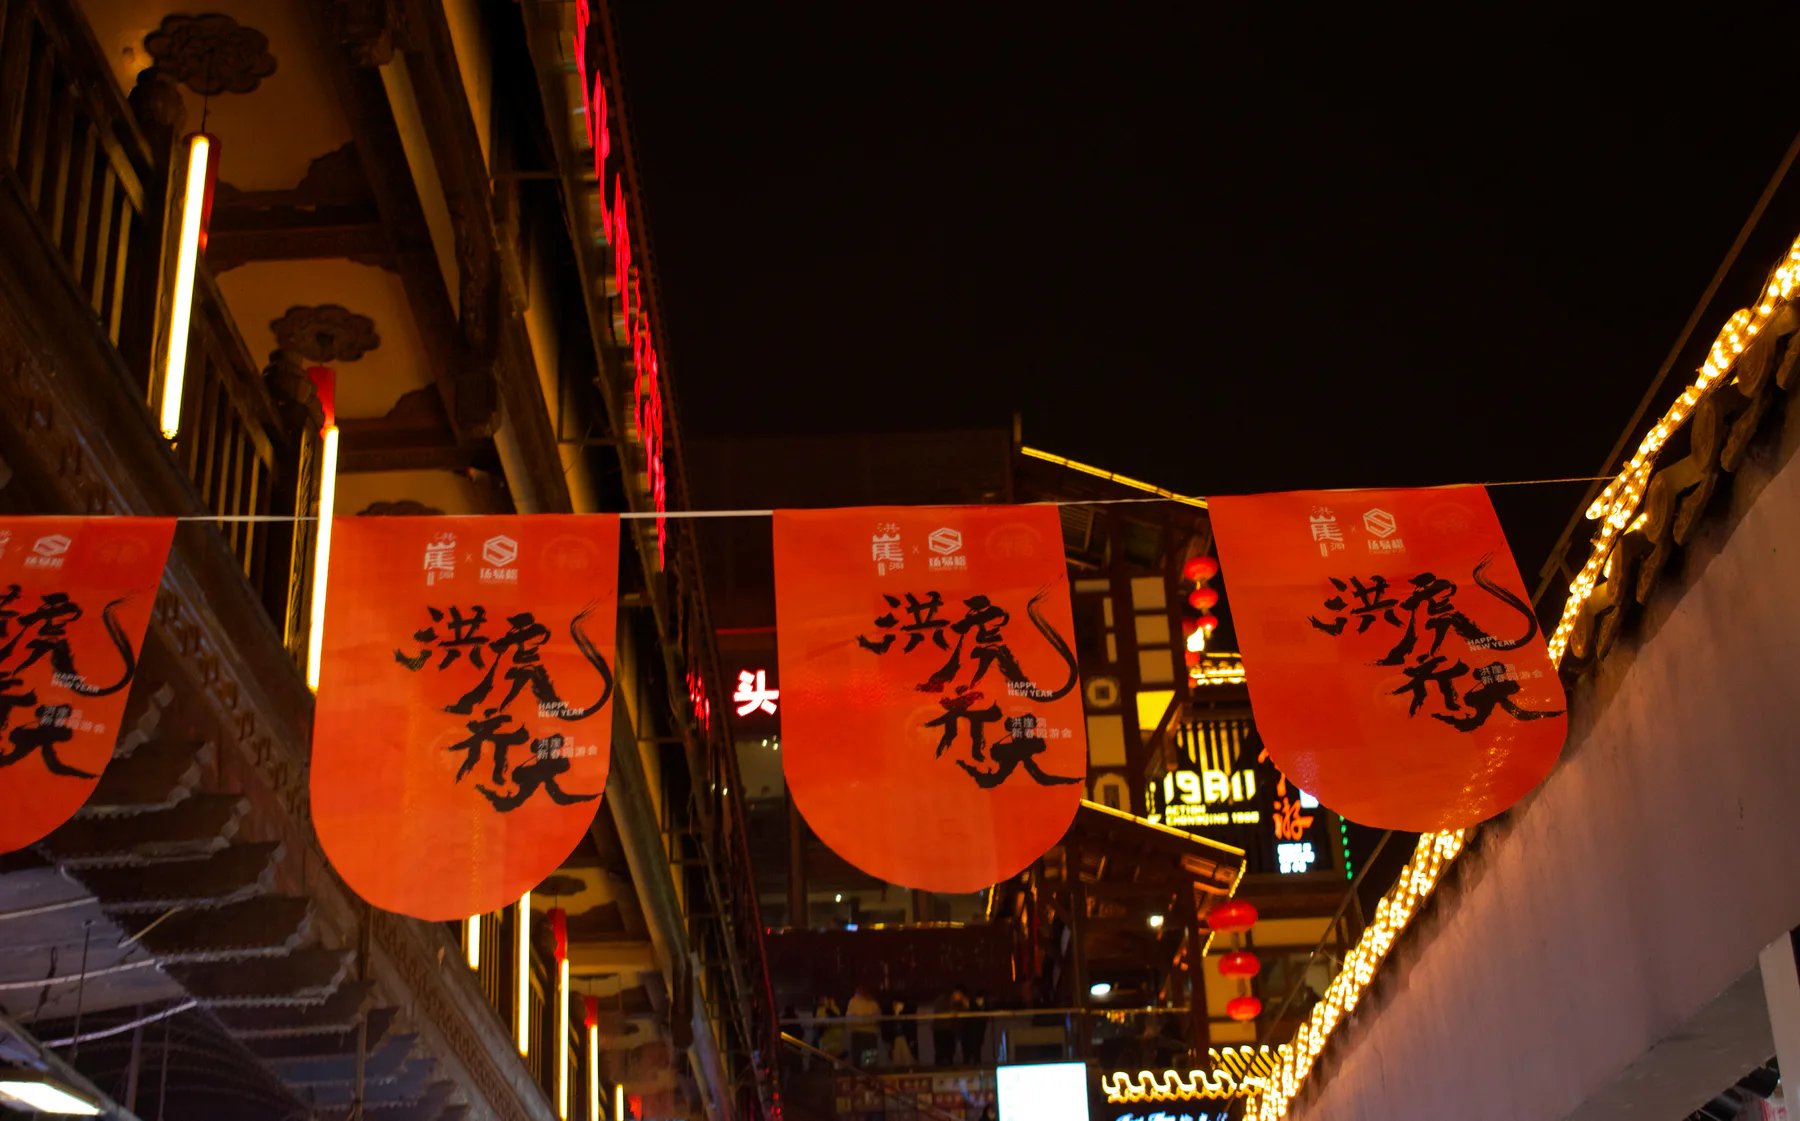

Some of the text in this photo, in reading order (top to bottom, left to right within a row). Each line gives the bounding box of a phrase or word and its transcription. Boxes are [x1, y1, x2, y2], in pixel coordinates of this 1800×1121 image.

[1467, 636, 1498, 647] HAPPY
[1469, 639, 1516, 652] NEW YEAR
[53, 671, 86, 682] HAPPY
[51, 678, 100, 693] NEW YEAR
[1007, 681, 1037, 690] HAPPY
[733, 669, 780, 717] 头
[1008, 689, 1053, 698] NEW YEAR
[538, 701, 569, 710] HAPPY
[538, 708, 584, 718] NEW YEAR
